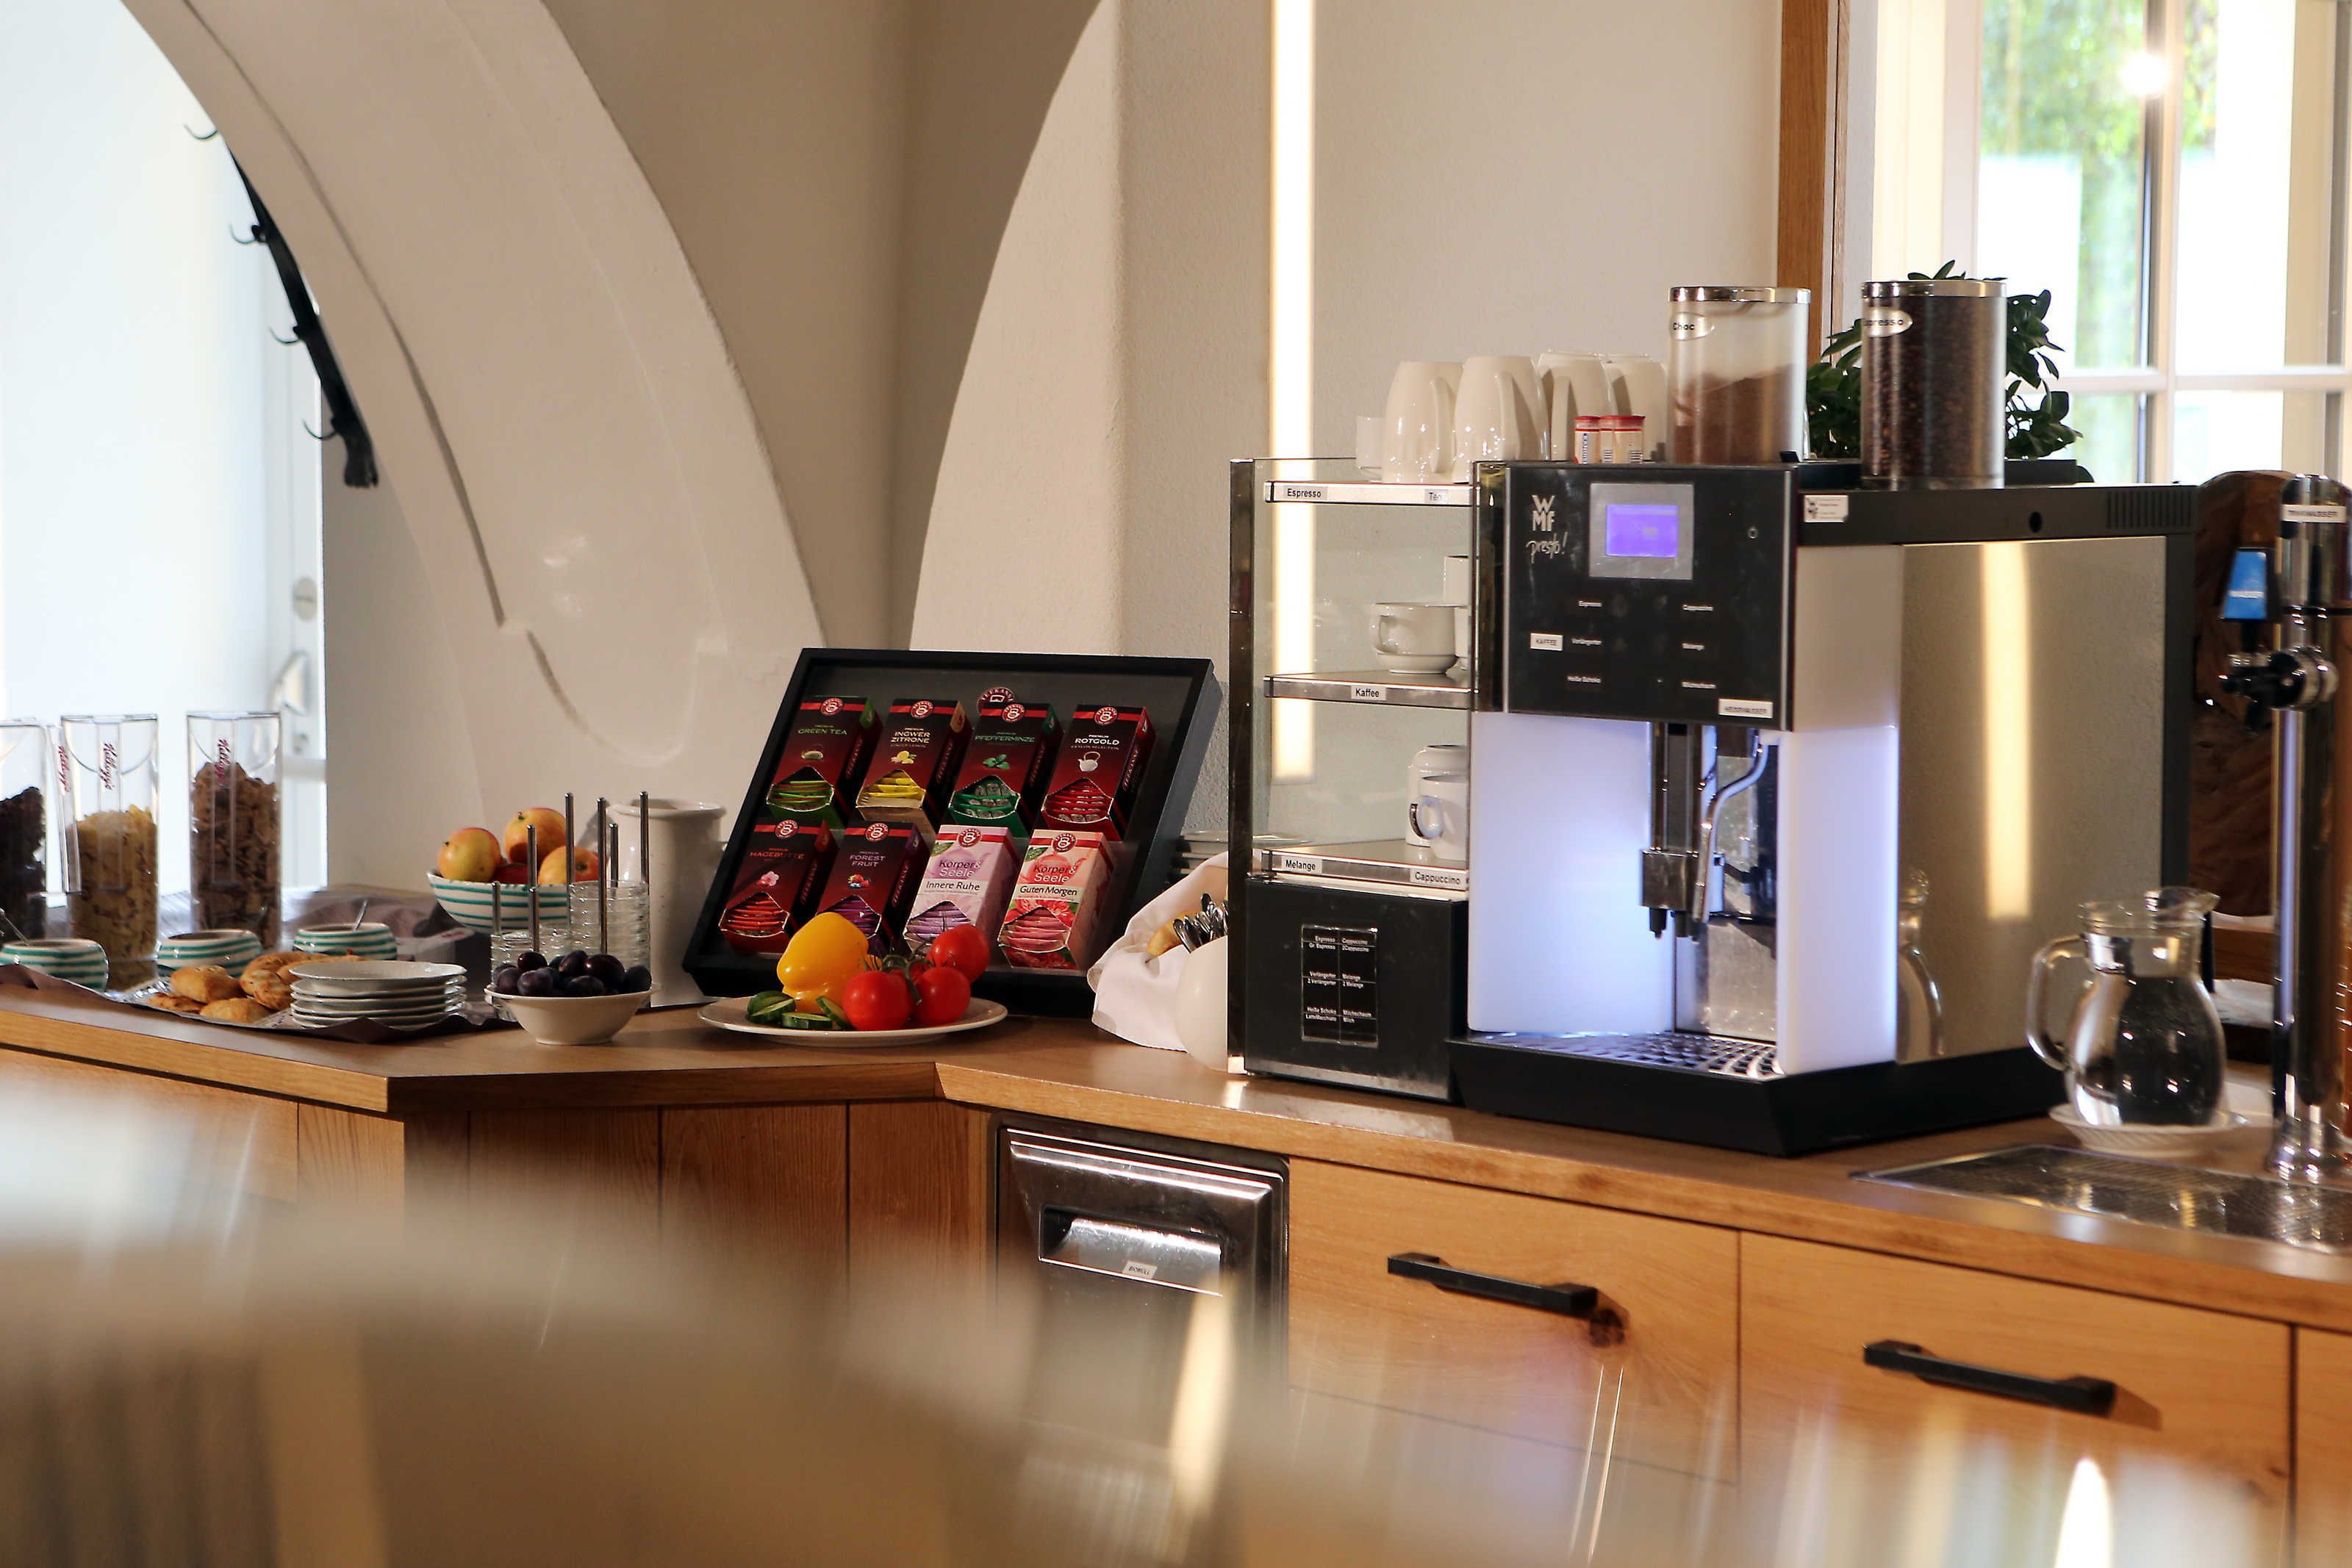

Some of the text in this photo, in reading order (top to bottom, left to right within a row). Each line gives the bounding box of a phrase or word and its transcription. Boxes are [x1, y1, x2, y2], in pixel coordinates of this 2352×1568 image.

[1287, 488, 1322, 498] Espresso
[1526, 531, 1568, 564] presto!
[1355, 688, 1380, 697] Kaffee
[975, 735, 1036, 743] PFEFFERMINZE
[1075, 738, 1120, 746] ROTGOLD
[939, 859, 974, 869] Körper
[1286, 859, 1316, 871] Melange
[939, 868, 974, 878] Seele
[1034, 865, 1078, 875] Körper &
[1034, 873, 1069, 882] Seele
[1415, 871, 1460, 884] Cappuccino
[926, 881, 980, 891] Innere Ruhe
[1019, 885, 1078, 898] Guten Morgen
